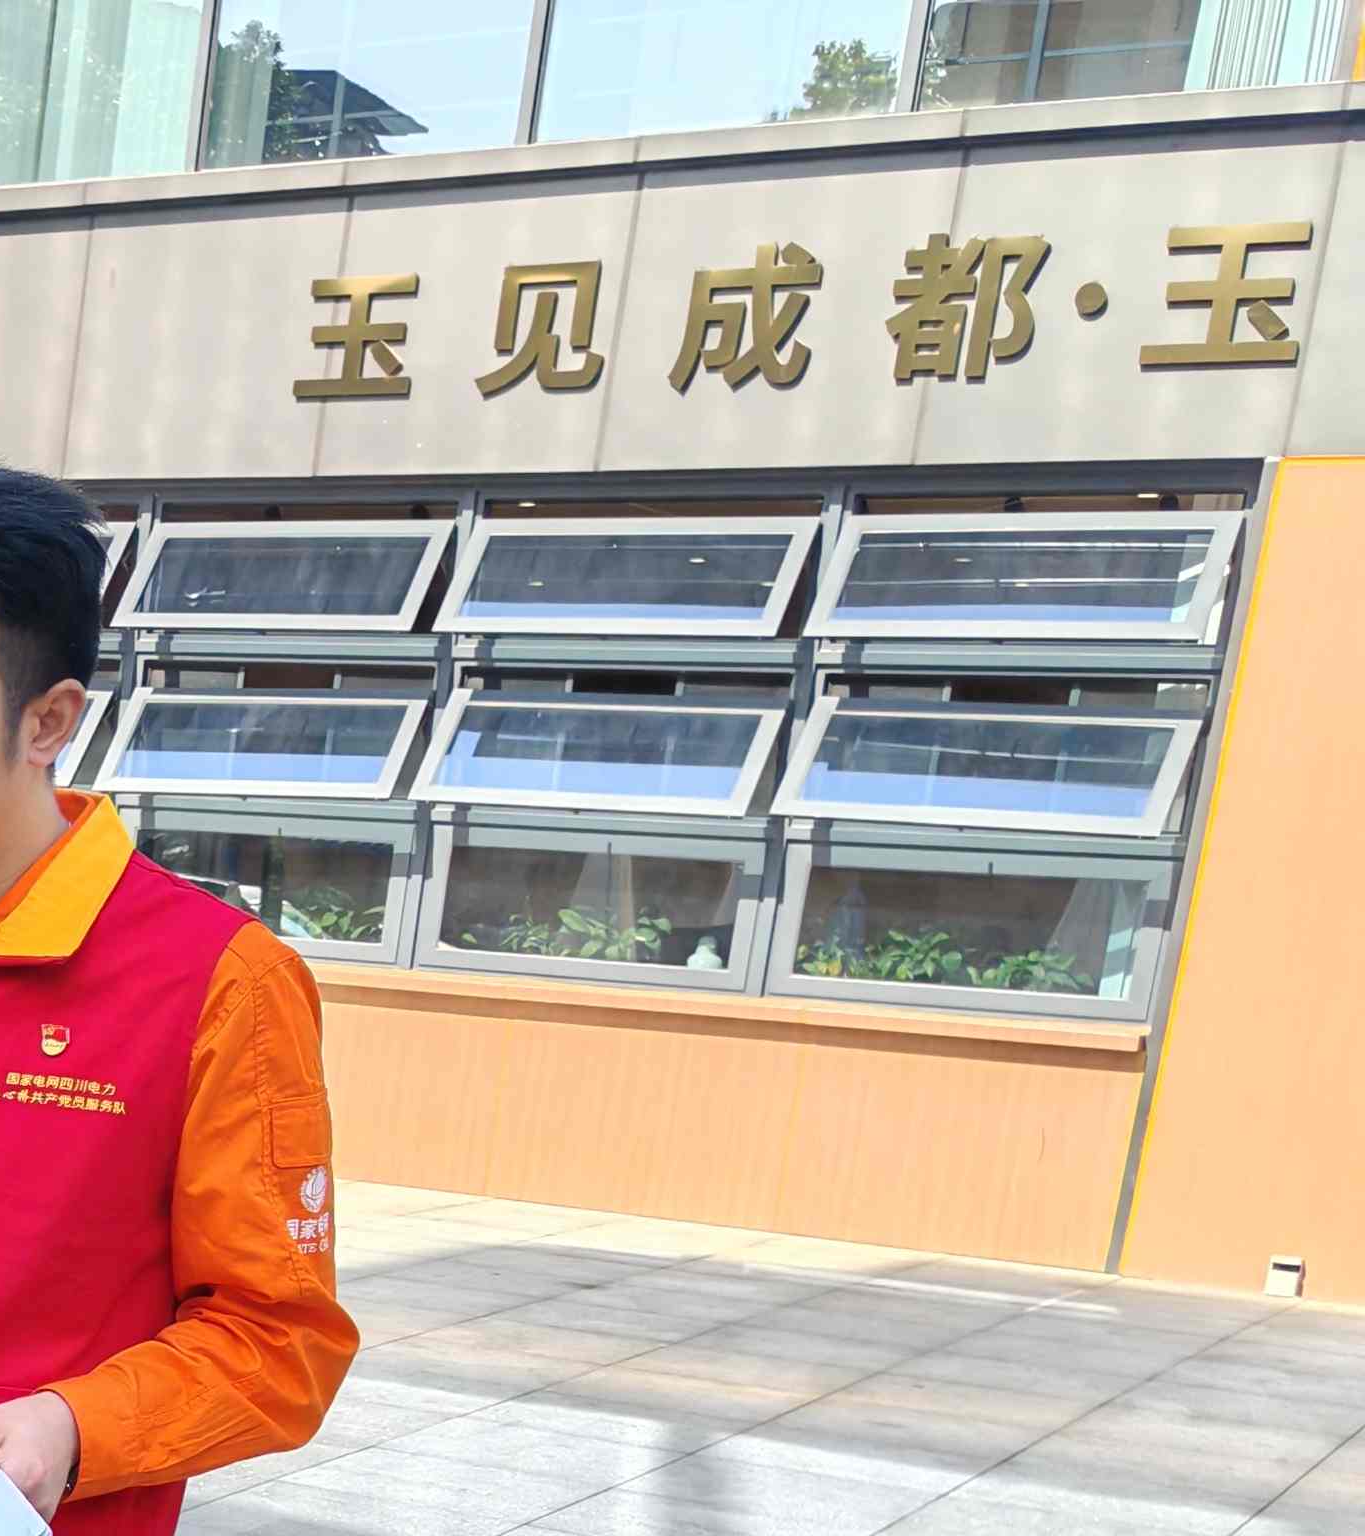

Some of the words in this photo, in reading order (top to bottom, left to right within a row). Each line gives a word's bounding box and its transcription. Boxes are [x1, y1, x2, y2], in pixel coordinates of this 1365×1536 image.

[5, 1071, 117, 1097] 国家电网四川电力
